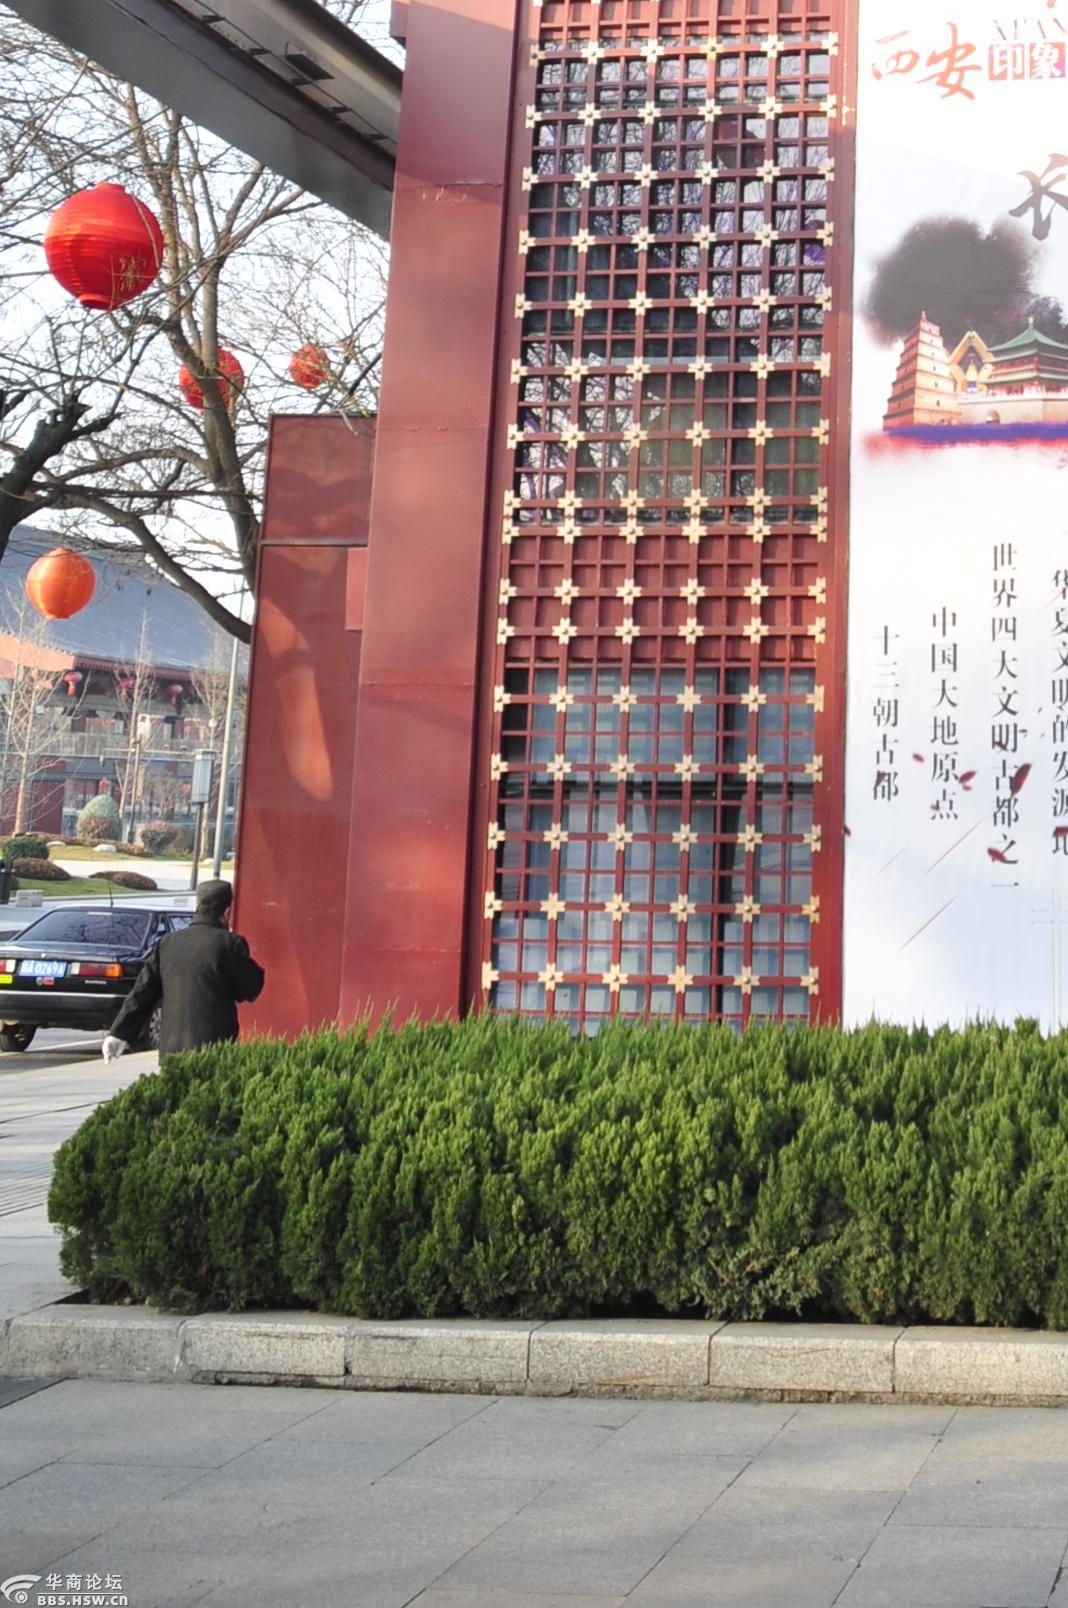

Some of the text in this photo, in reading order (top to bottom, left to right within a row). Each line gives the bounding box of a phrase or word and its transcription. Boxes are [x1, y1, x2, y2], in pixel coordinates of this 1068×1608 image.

[872, 625, 900, 803] 十三朝古都
[930, 606, 960, 821] 中国大地原点
[991, 543, 1020, 888] 世界四大文明古都之一
